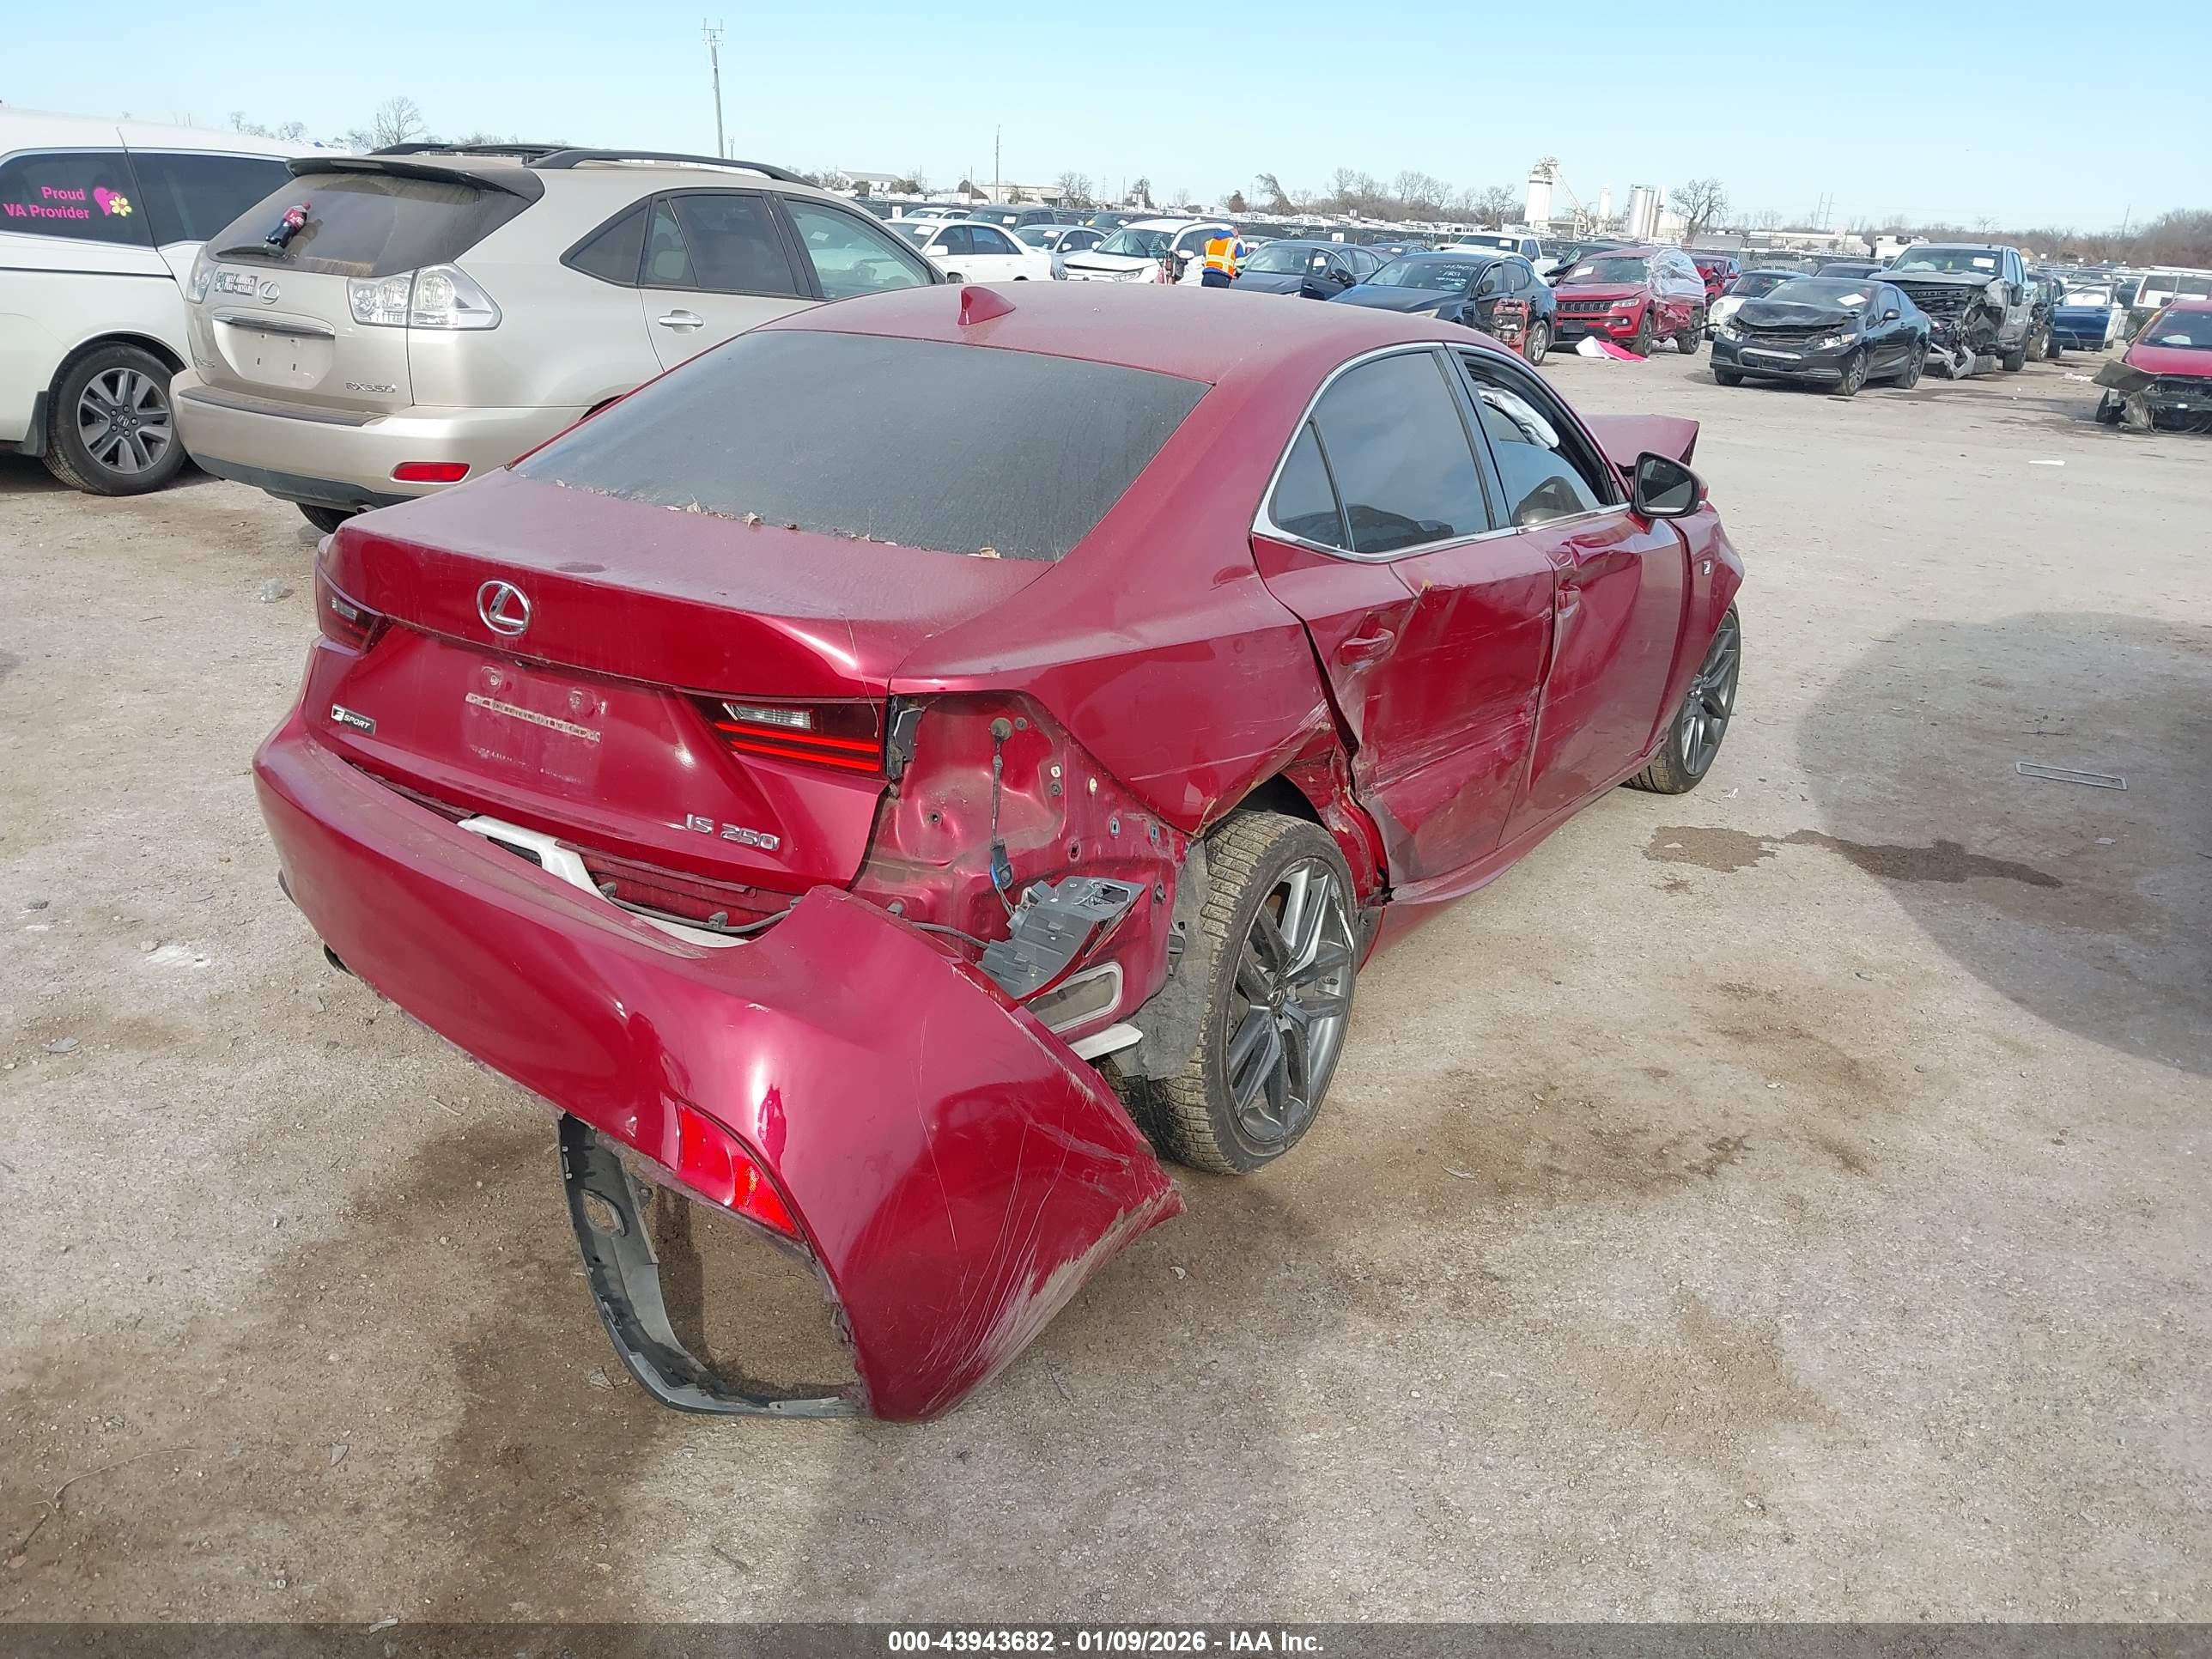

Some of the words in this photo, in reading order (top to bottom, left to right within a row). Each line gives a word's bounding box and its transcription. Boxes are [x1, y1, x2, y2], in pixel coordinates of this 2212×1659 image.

[41, 186, 86, 201] Proud
[3, 204, 27, 217] VA
[29, 204, 90, 219] Provider
[343, 712, 371, 729] SPORT
[685, 812, 714, 835] IS
[721, 823, 781, 851] 250
